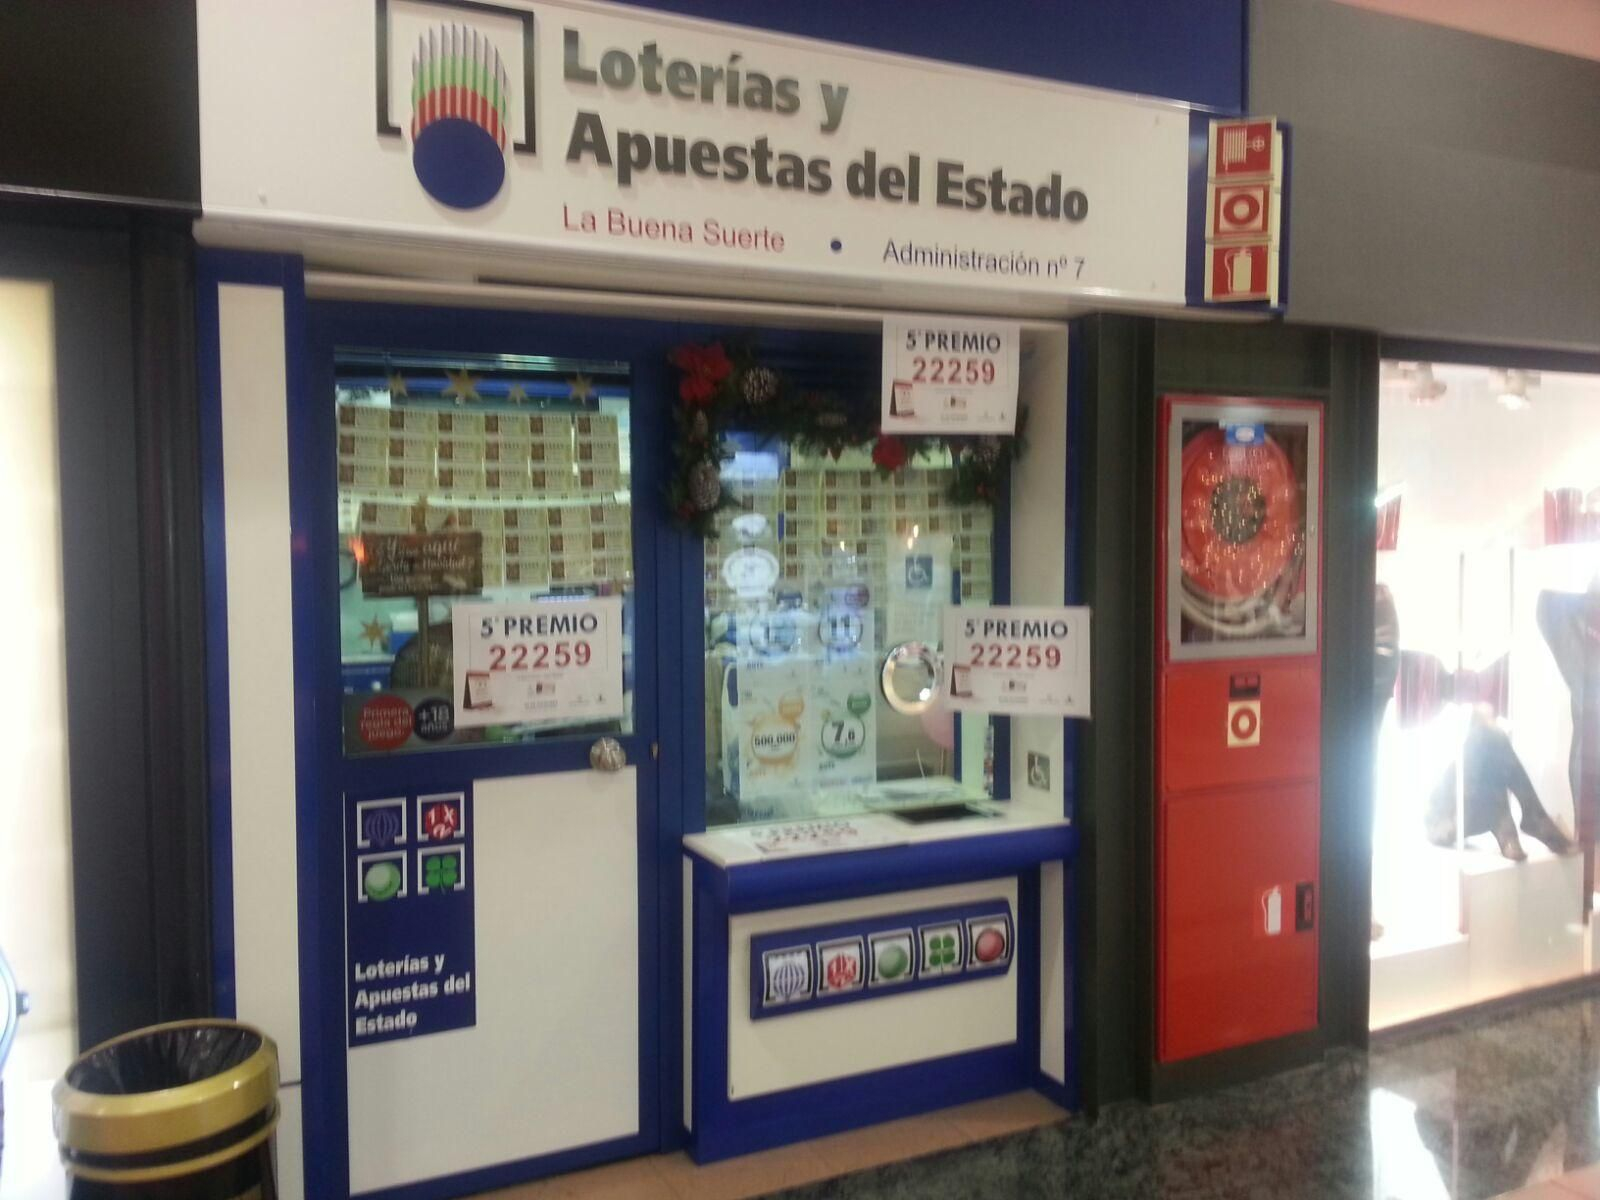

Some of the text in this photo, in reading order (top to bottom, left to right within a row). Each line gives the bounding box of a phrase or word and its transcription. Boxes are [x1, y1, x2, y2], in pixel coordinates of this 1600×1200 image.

[563, 27, 850, 134] Loterías y
[565, 109, 1089, 223] Apuestas del Estado
[563, 202, 785, 253] La Buena Suerte
[883, 237, 1039, 277] Administración
[1074, 256, 1086, 280] 7
[925, 330, 1001, 354] PREMIO
[912, 356, 995, 386] 22259
[504, 612, 598, 637] PREMIO
[984, 618, 1068, 640] PREMIO
[489, 640, 591, 671] 22259
[970, 642, 1061, 669] 22259
[355, 953, 445, 982] Loterías y
[355, 972, 470, 1012] Apuestas del
[355, 1008, 417, 1037] Estado
